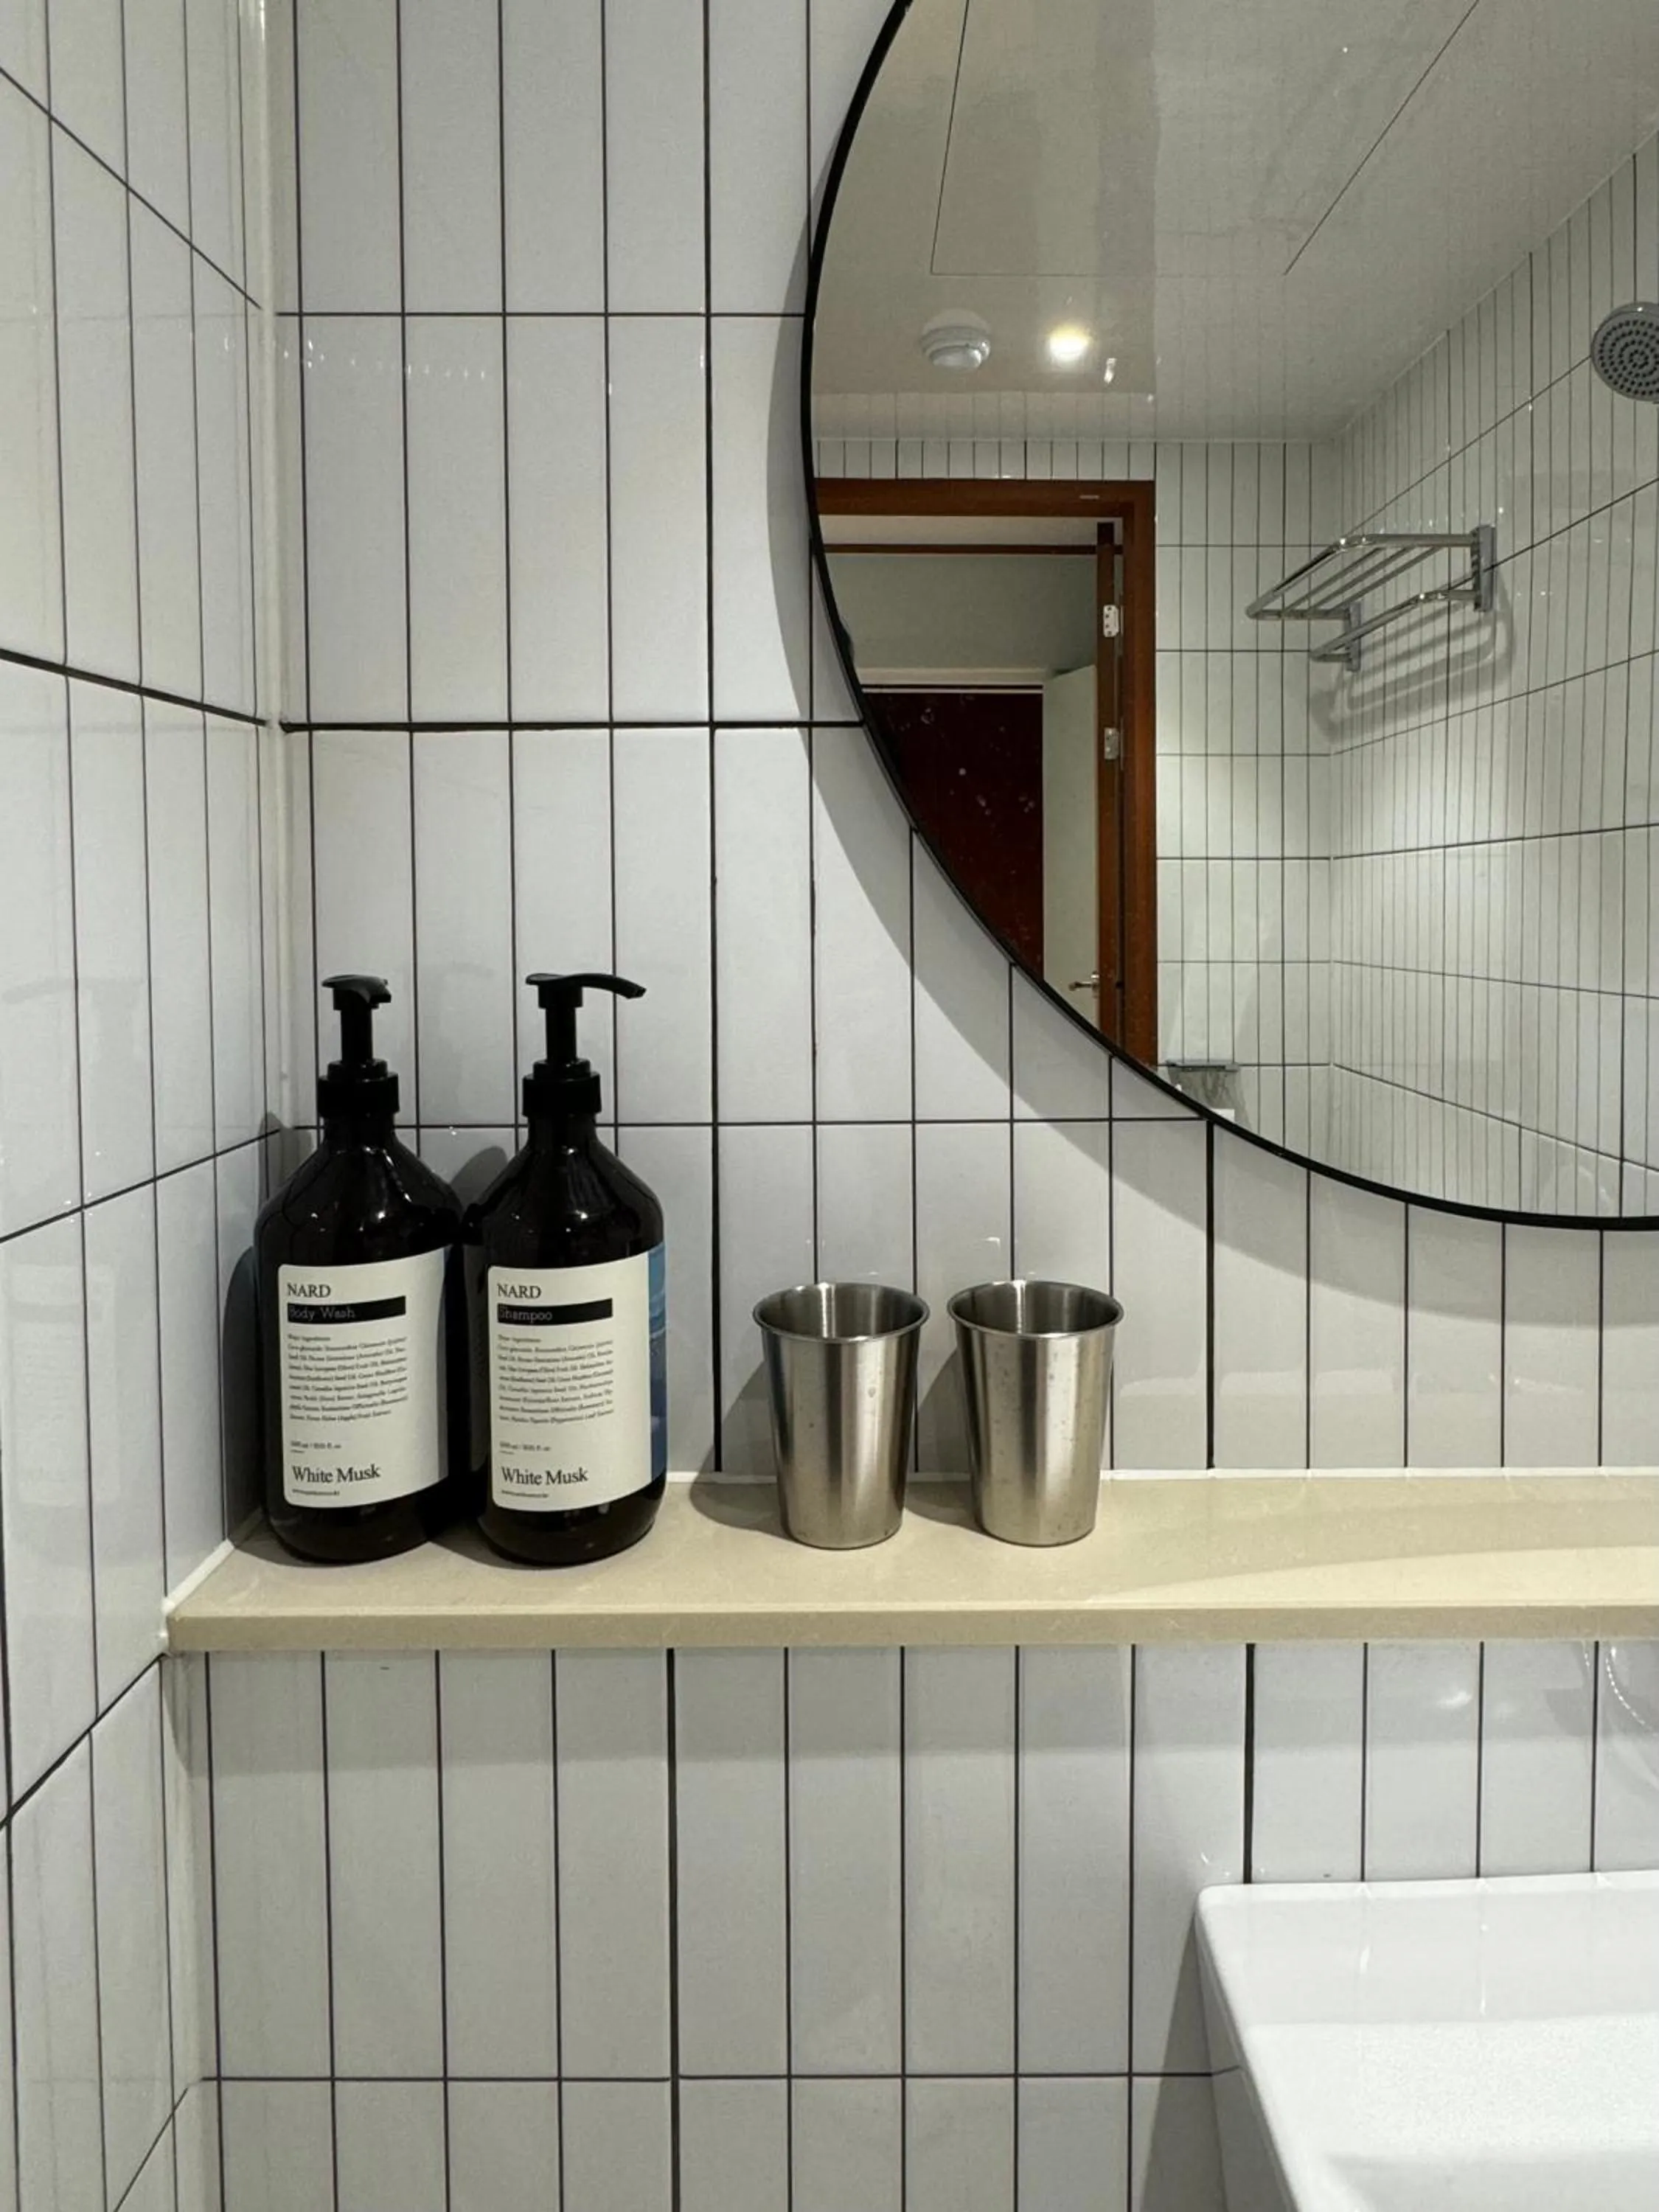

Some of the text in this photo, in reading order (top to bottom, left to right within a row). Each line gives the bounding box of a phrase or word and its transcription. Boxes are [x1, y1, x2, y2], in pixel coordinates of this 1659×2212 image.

[287, 1282, 331, 1298] NARD
[497, 1283, 542, 1298] NARD
[288, 1305, 356, 1322] Body Wash
[498, 1304, 553, 1324] Shampoo
[292, 1463, 381, 1483] White Musk
[501, 1466, 589, 1485] White Musk
